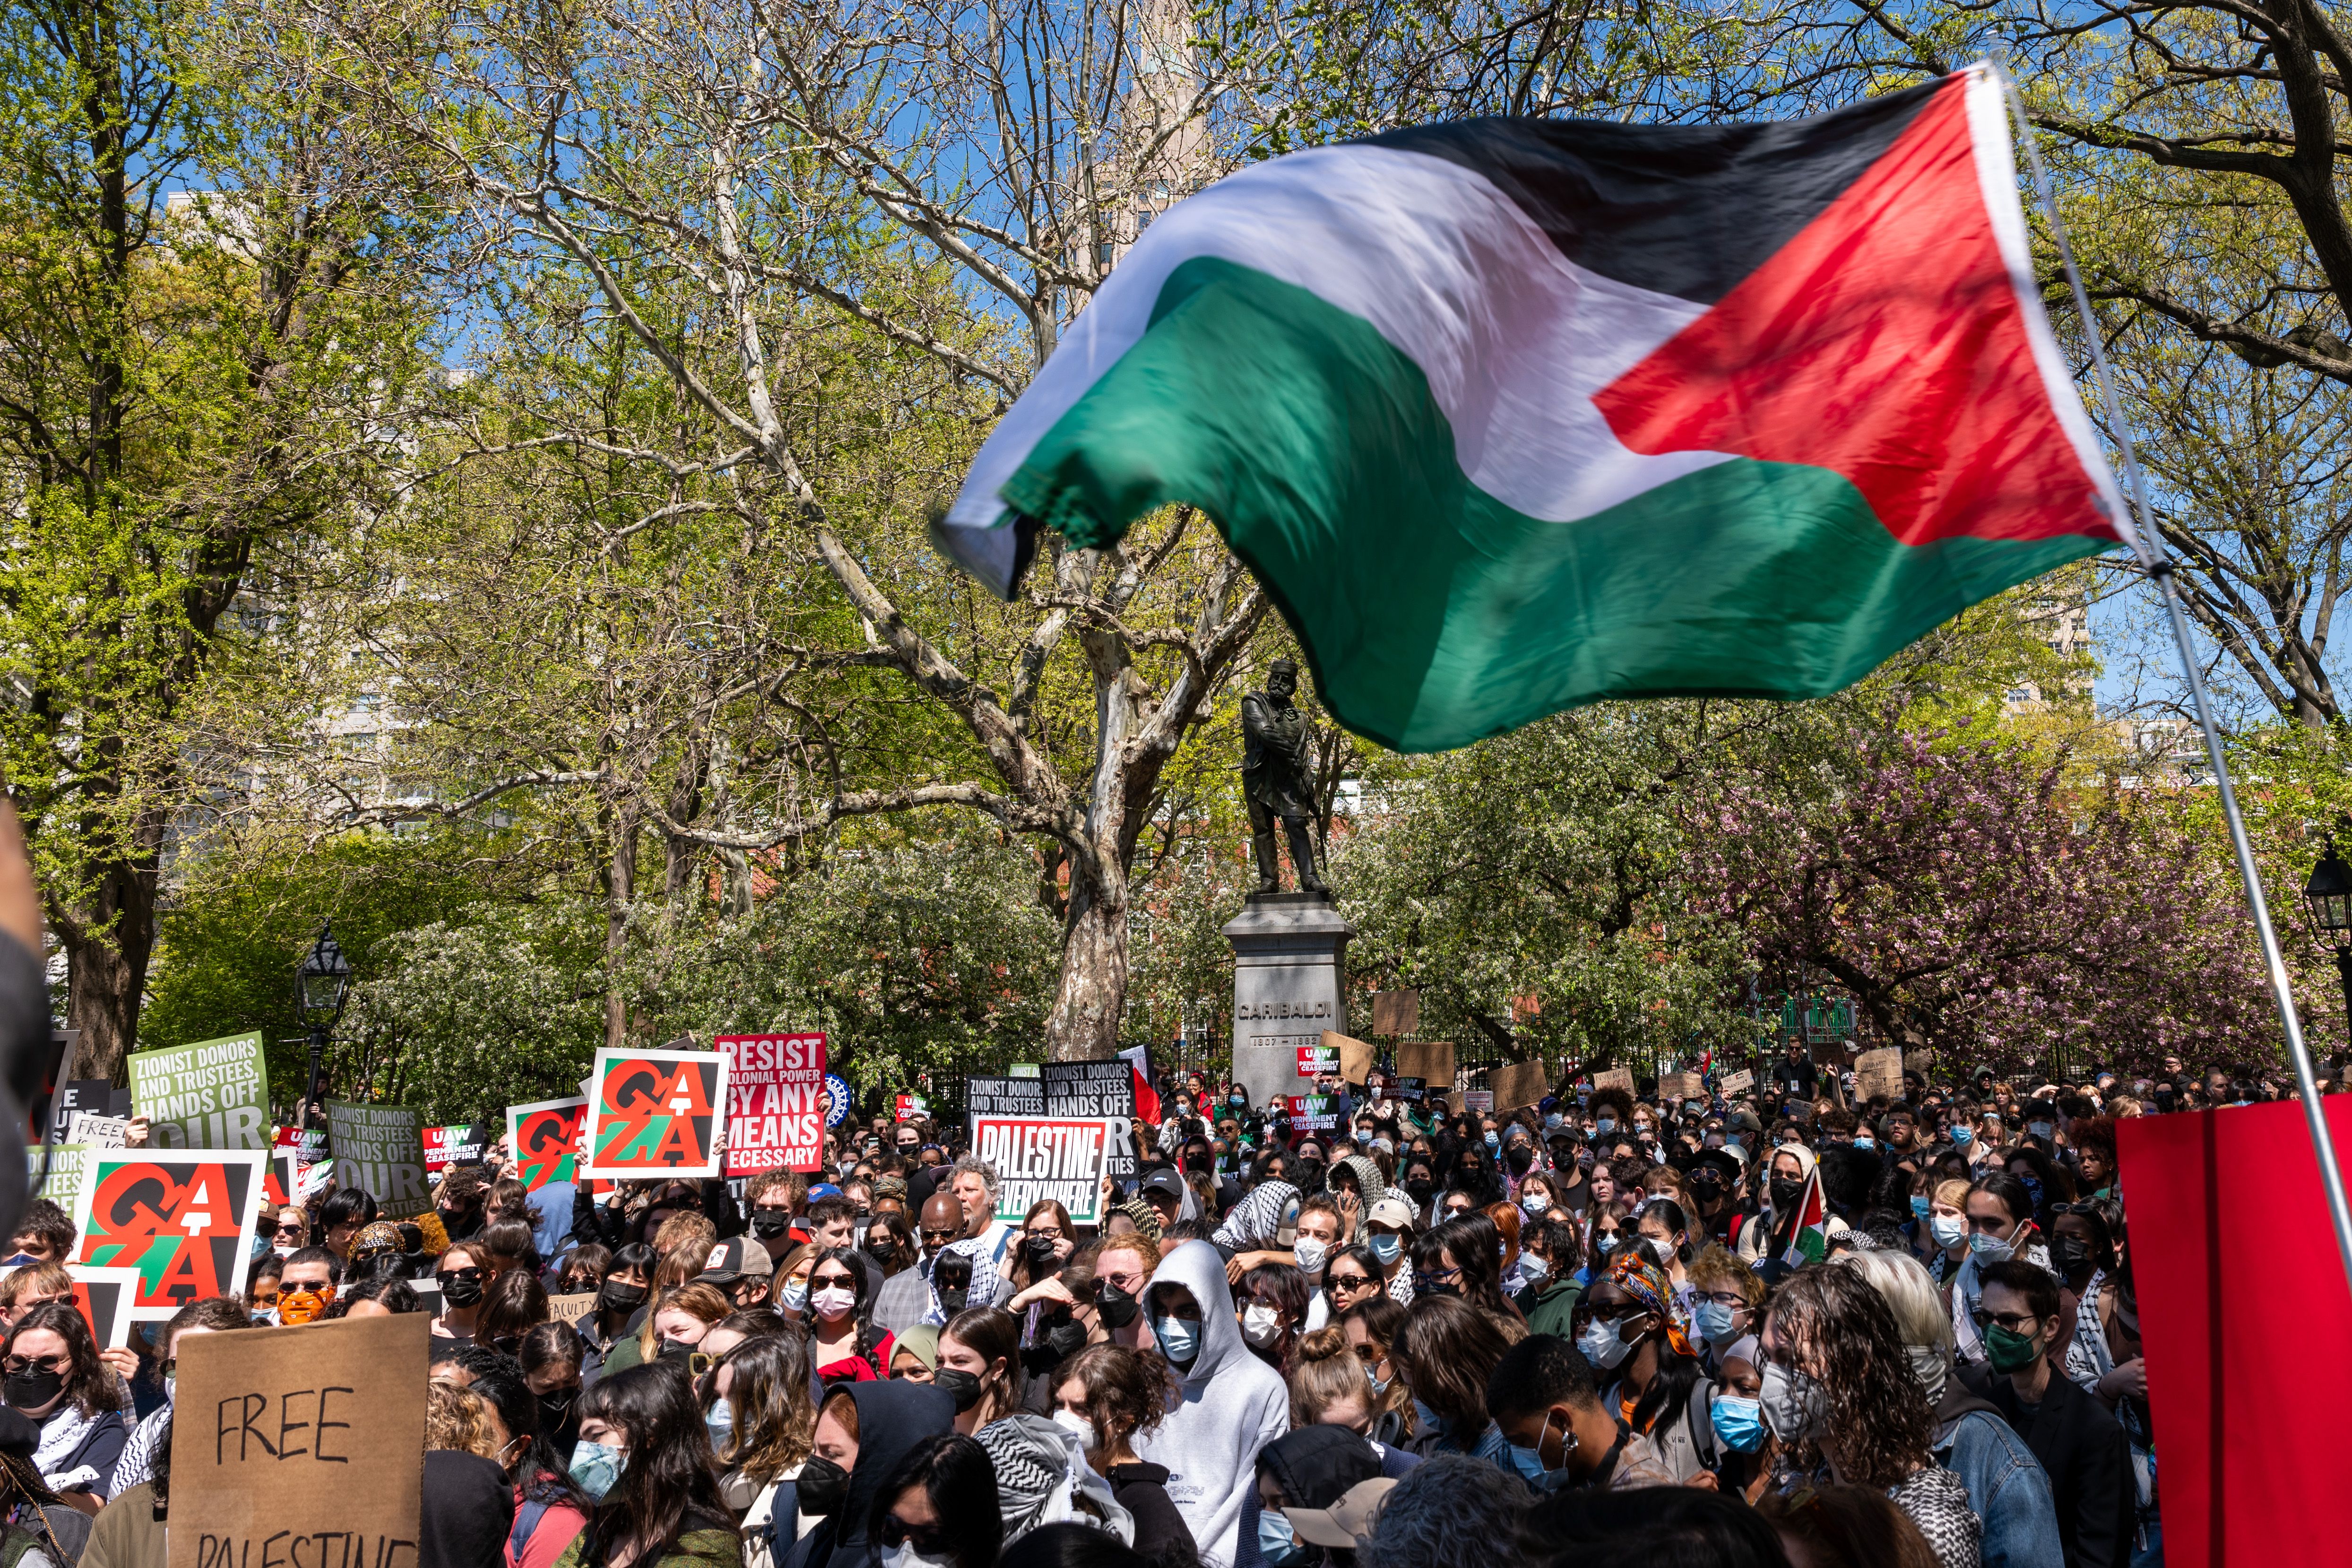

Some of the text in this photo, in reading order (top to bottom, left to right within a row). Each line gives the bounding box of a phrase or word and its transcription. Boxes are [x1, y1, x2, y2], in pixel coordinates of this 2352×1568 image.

[1238, 1001, 1331, 1020] GARIBALDI
[1253, 1038, 1276, 1046] 1807
[1293, 1037, 1317, 1045] 1882
[136, 1039, 256, 1079] ZIONIST DONORS
[720, 1039, 821, 1071] RESIST
[1305, 1049, 1332, 1058] UAW
[1400, 1045, 1418, 1062] NO
[1011, 1067, 1031, 1077] ZIONIST
[1045, 1065, 1084, 1081] ZIONIST
[1088, 1064, 1129, 1079] DONORS
[1400, 1062, 1418, 1076] ON
[1860, 1061, 1886, 1071] SHAME
[139, 1060, 259, 1100] AND TRUSTEES,
[728, 1069, 820, 1084] OLONIAL POWER
[1841, 1072, 1849, 1081] NEW
[971, 1080, 1005, 1096] ZIONIST
[1047, 1079, 1130, 1097] AND TRUSTEES,
[140, 1079, 259, 1124] HANDS OFF
[725, 1084, 756, 1116] BY
[762, 1082, 821, 1115] ANY
[905, 1097, 926, 1108] UAW
[971, 1096, 990, 1110] AND
[1048, 1095, 1131, 1117] HANDS OFF
[1296, 1098, 1328, 1111] UAW
[330, 1104, 416, 1126] ZIONIST DONORS
[1291, 1114, 1338, 1123] PERMANENT
[332, 1121, 417, 1144] AND TRUSTEES,
[724, 1114, 819, 1149] MEANS
[1294, 1121, 1335, 1130] CEASEFIRE
[291, 1131, 326, 1144] UAW
[432, 1128, 472, 1143] UAW
[333, 1136, 418, 1163] HANDS OFF
[424, 1144, 482, 1156] PERMANENT
[426, 1151, 478, 1163] CEASEFIRE
[981, 1125, 1101, 1179] PALESTINE
[298, 1161, 334, 1183] UAW
[337, 1159, 425, 1203] OUR
[549, 1300, 597, 1319] FACULTY
[217, 1386, 355, 1465] FREE
